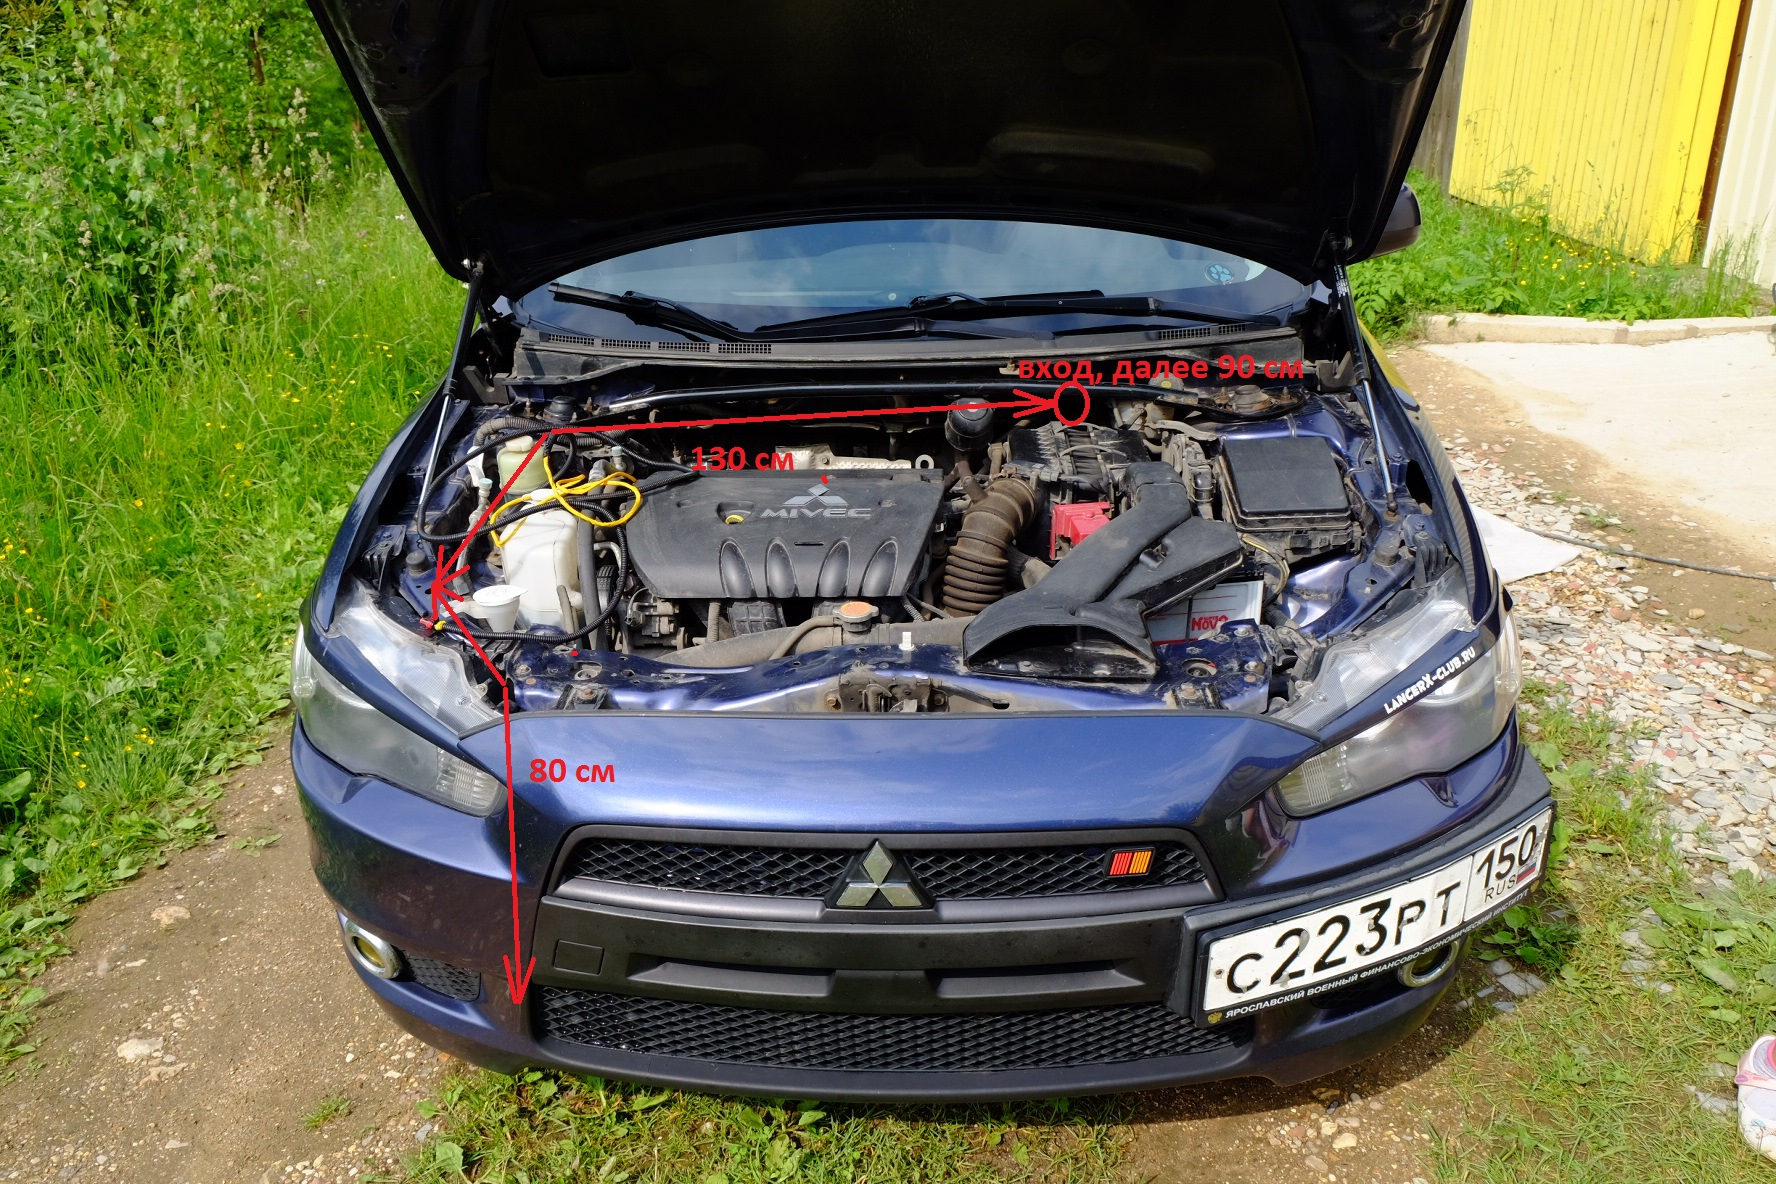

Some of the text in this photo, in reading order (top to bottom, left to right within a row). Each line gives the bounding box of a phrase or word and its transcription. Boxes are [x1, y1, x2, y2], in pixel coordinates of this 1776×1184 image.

[760, 508, 872, 519] MIVEC
[1384, 646, 1476, 714] LANCERX-CLUB.RU
[1476, 825, 1537, 890] 150
[1484, 874, 1516, 903] RUS
[1225, 888, 1530, 1019] ЯРОСЛАВСКИЙ ВОЕННЫЙ ФИНАНСОВО-ЭКОНОМИЧЕСКИЙ ИНСТИТУТ
